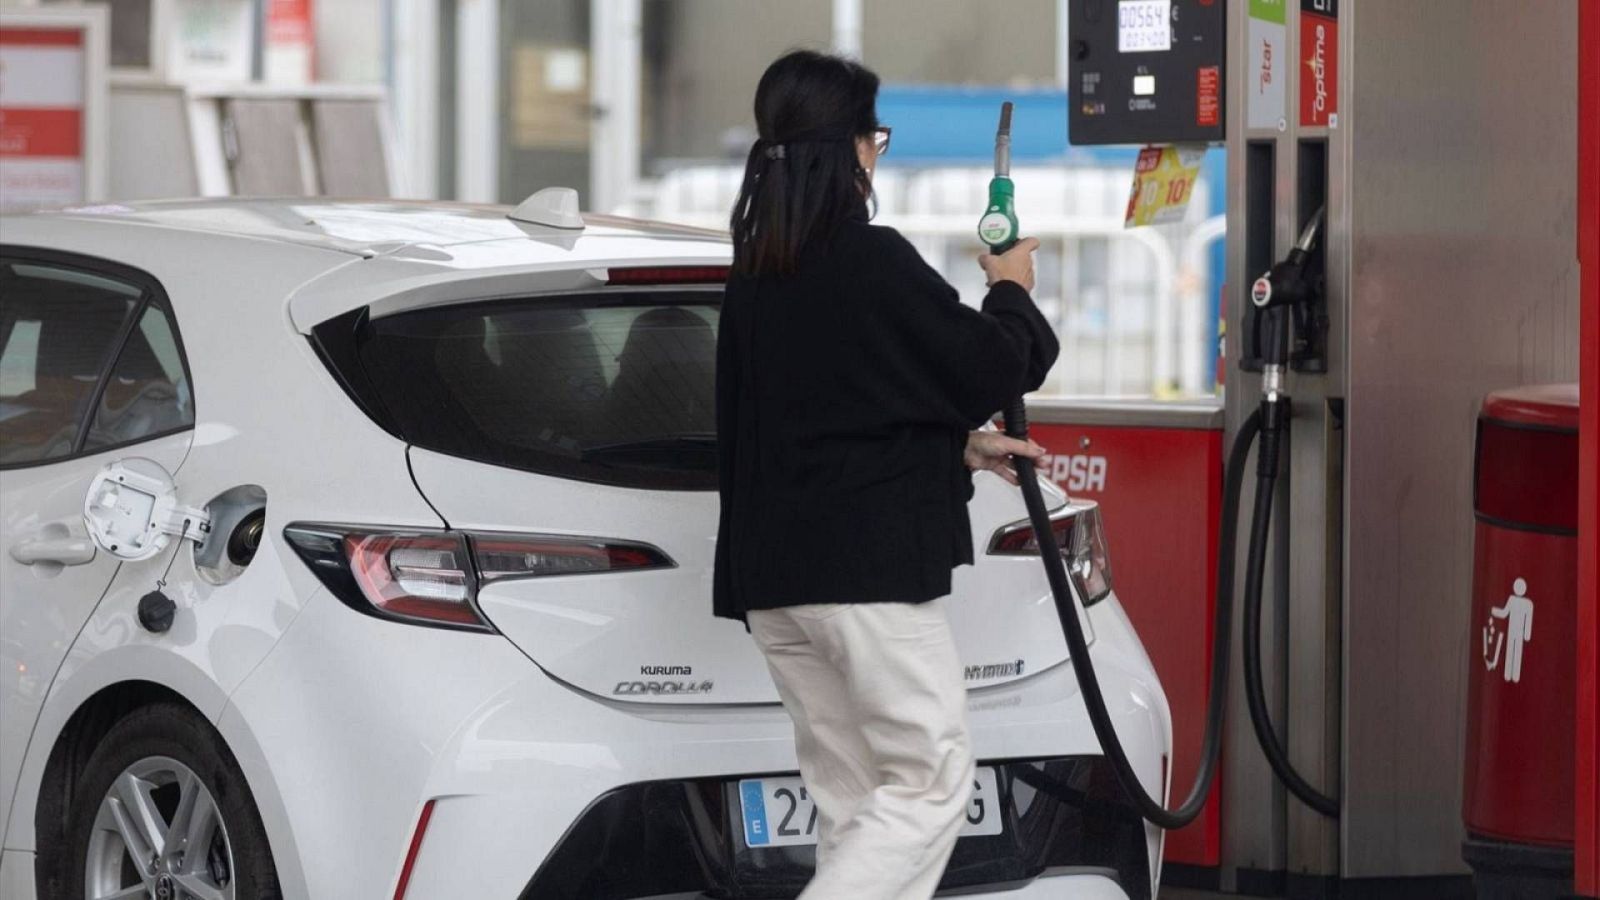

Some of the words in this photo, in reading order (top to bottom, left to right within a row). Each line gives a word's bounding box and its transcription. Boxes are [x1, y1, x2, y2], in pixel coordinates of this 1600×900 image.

[1120, 5, 1163, 28] 00564
[1262, 38, 1272, 85] star
[1315, 24, 1328, 111] optima
[752, 819, 762, 834] E
